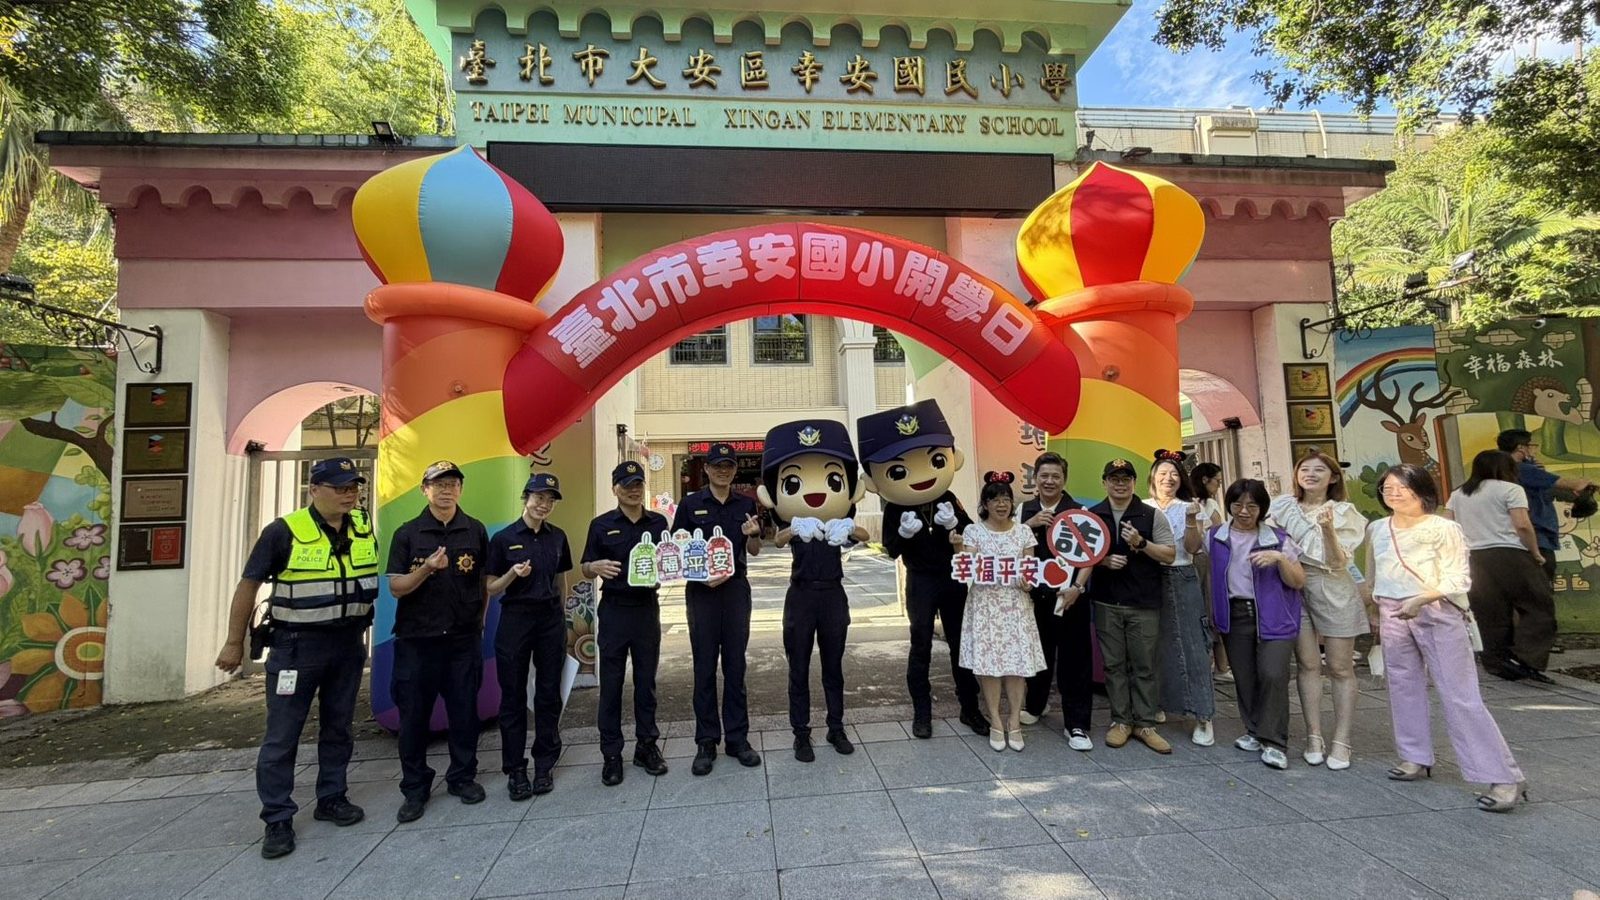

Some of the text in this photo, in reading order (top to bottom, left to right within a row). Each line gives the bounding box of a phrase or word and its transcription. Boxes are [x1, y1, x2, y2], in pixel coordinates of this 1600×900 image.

[459, 39, 1073, 101] 臺北市大安區幸安國民小學
[469, 101, 1065, 137] TAIPEI MUNICIPAL XINGAN ELEMENTARY SCHOOL
[547, 231, 1033, 370] 臺北市幸安國小開學日
[1463, 350, 1564, 380] 幸福森林
[634, 551, 731, 577] 幸福平安
[952, 554, 1040, 585] 幸福平安
